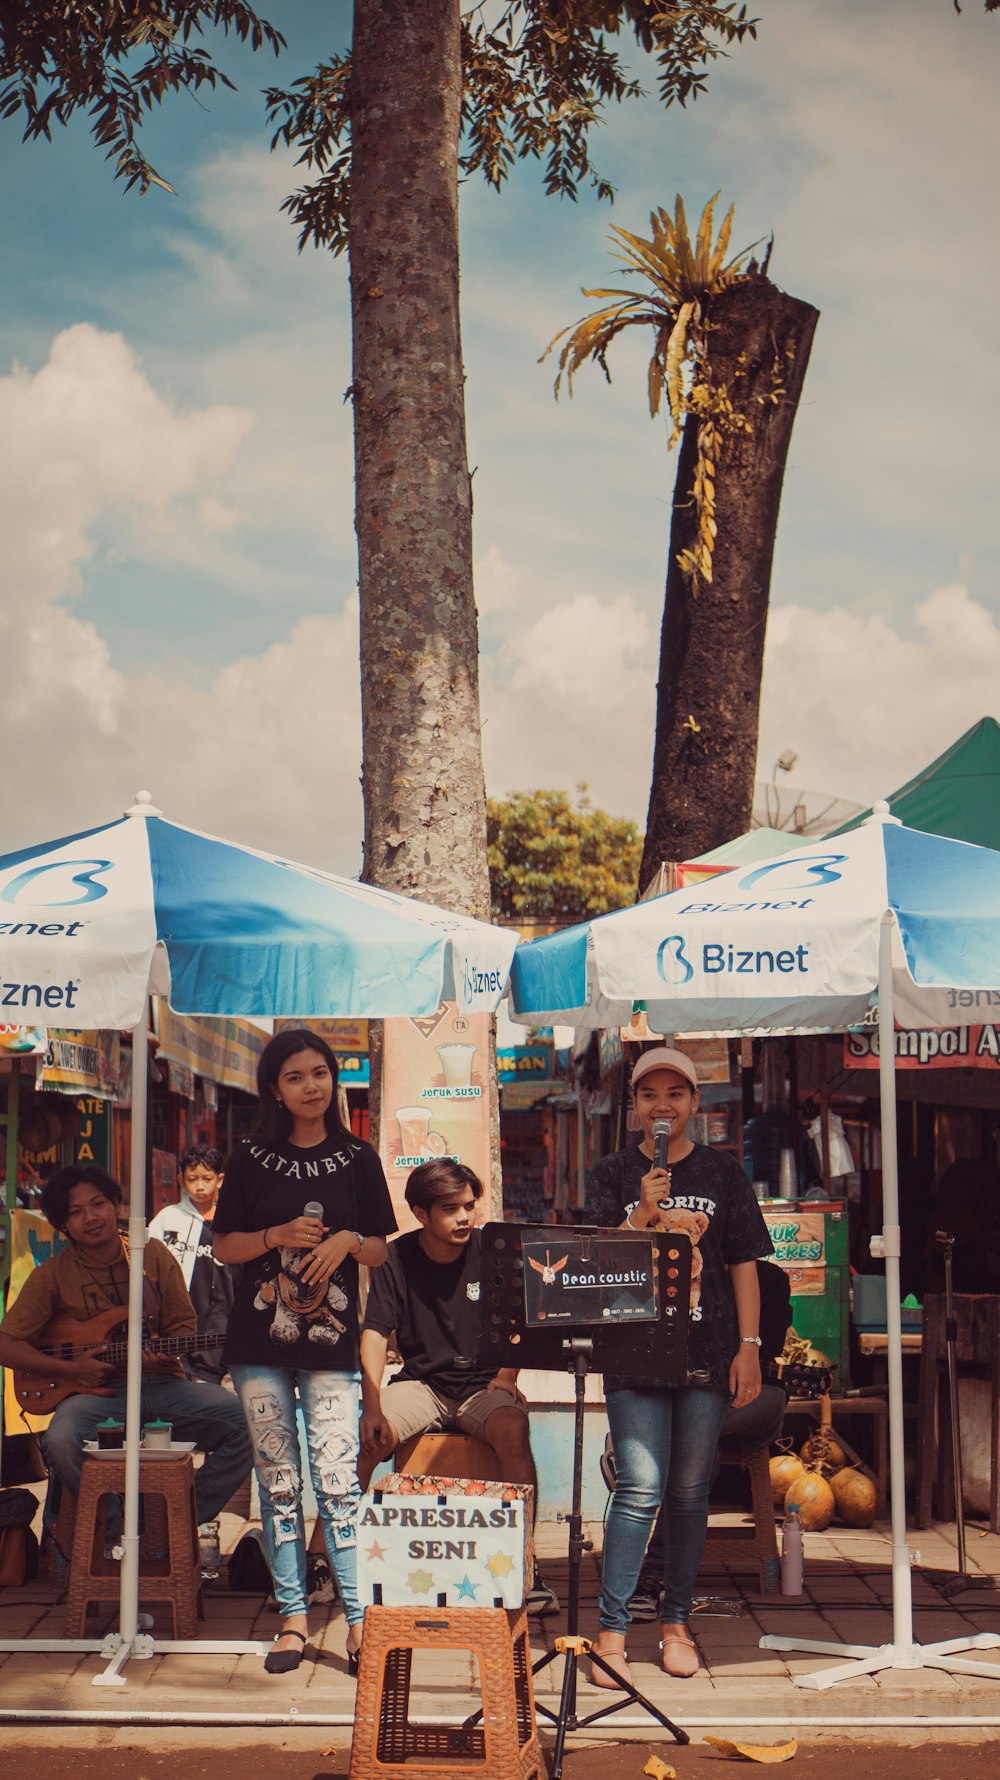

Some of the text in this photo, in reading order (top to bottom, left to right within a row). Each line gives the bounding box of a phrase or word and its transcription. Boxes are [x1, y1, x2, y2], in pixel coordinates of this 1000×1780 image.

[677, 897, 816, 914] Biznet
[703, 943, 809, 973] Biznet
[0, 980, 79, 1008] znet
[624, 1195, 716, 1217] FORITE
[359, 1507, 518, 1528] APRESIASI
[407, 1540, 477, 1560] SENI
